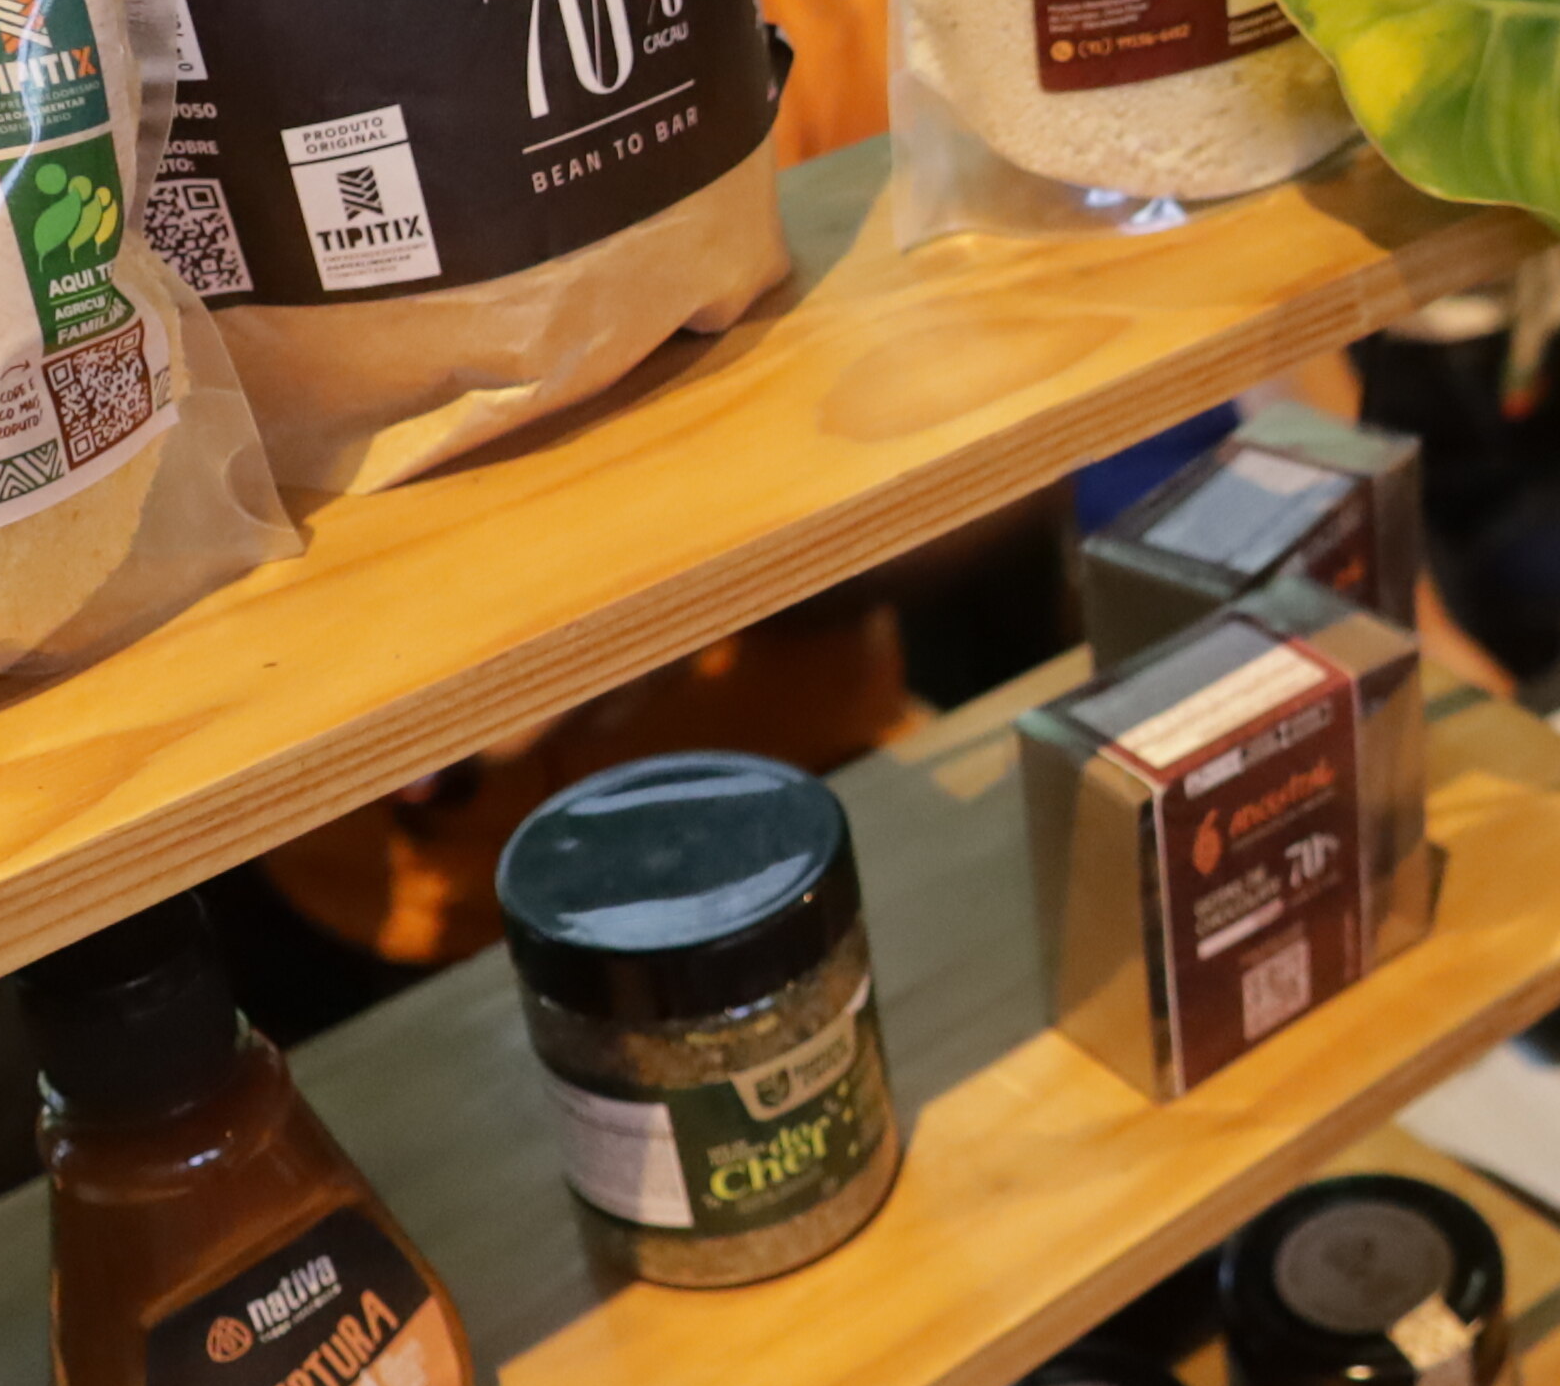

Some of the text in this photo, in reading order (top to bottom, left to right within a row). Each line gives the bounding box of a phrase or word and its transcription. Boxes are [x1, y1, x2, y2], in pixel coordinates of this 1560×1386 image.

[643, 21, 689, 55] CACAU
[302, 116, 383, 143] PRODUTO
[306, 129, 388, 155] ORIGINAL
[531, 105, 700, 194] BEAN TO BAR
[316, 214, 424, 252] TIPITIX
[48, 268, 96, 299] AQUI
[246, 1254, 339, 1334] nativa
